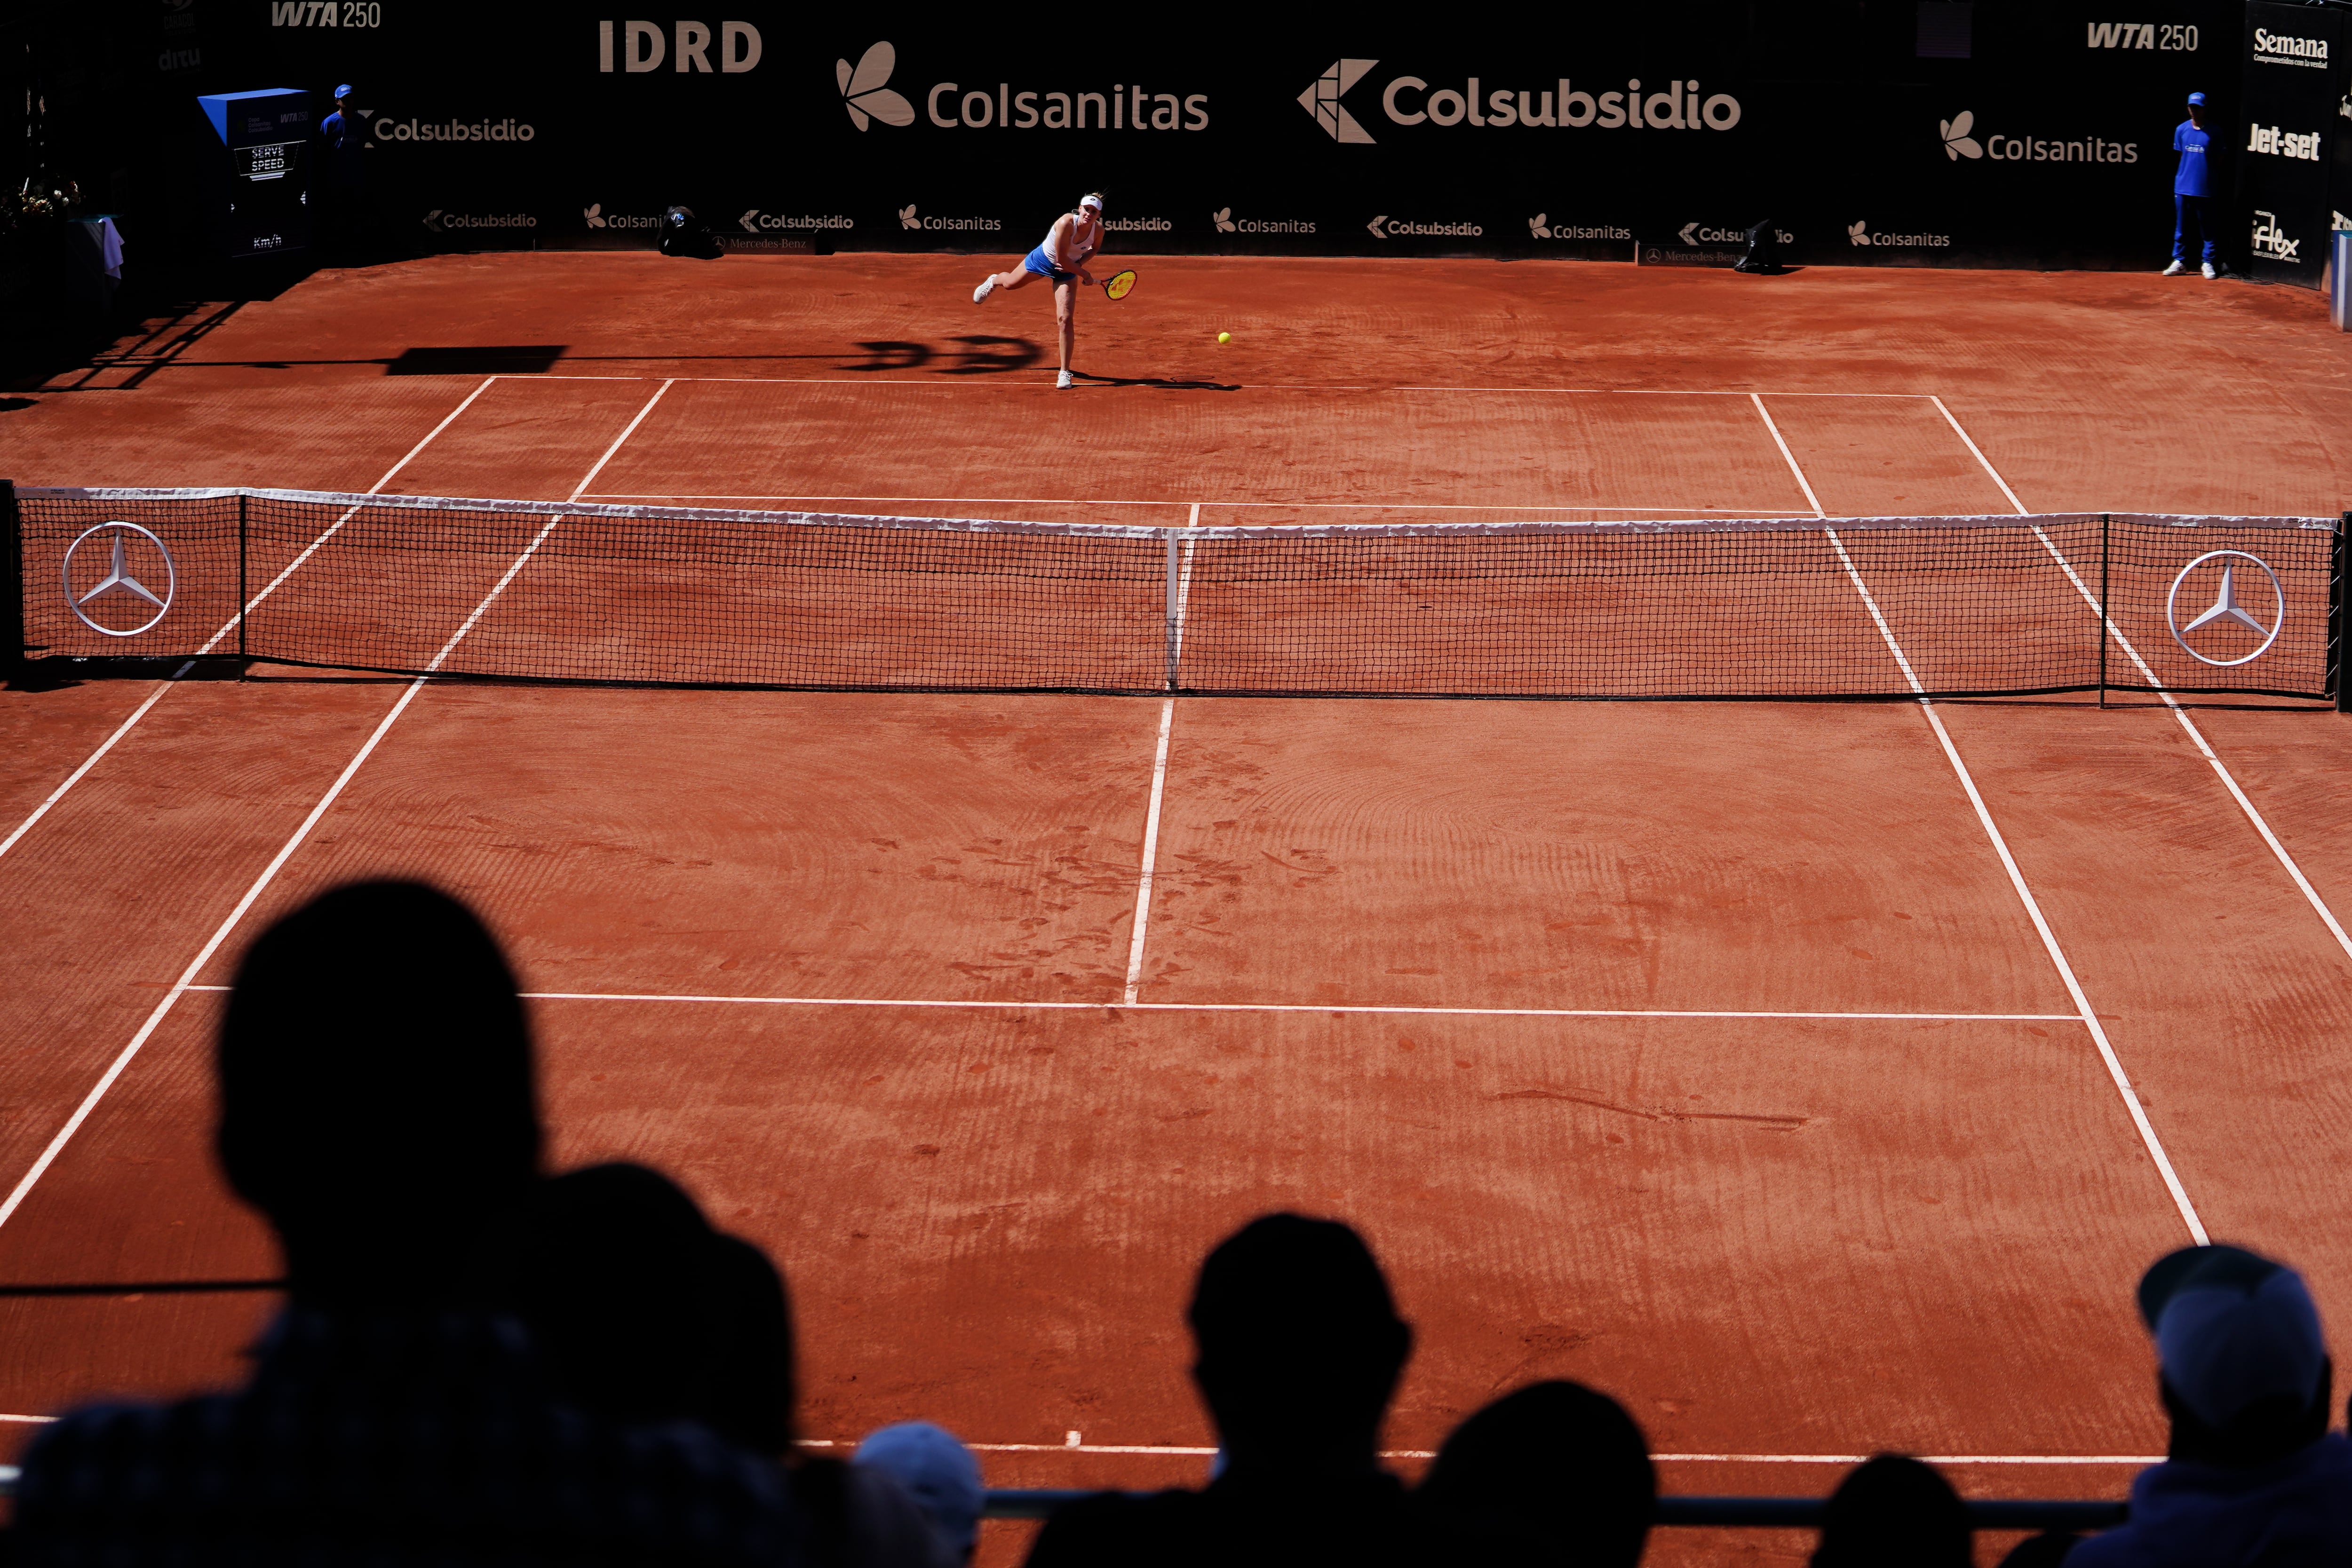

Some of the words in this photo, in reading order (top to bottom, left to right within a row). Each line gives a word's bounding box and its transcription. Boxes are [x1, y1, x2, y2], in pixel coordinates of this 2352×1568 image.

[272, 1, 337, 27] WTA
[343, 2, 381, 28] 250
[2088, 22, 2154, 49] WTA
[2160, 24, 2199, 51] 250
[2254, 28, 2328, 59] Semana
[599, 20, 763, 73] IDRD
[927, 82, 1209, 131] Colsanitas
[1382, 76, 1741, 131] Colsubsidio
[280, 112, 297, 123] WTA
[298, 111, 308, 121] 250
[374, 118, 535, 141] Colsubsidio
[1988, 135, 2138, 163] Colsanitas
[2247, 123, 2321, 161] Jet-set
[252, 145, 285, 159] SERVE
[252, 158, 285, 171] SPEED
[444, 214, 537, 228] Colsubsidio
[608, 214, 667, 228] Colsani
[759, 214, 854, 229] Colsubsidio
[923, 216, 1001, 230] Colsanitas
[1238, 219, 1316, 233] Colsanitas
[1388, 220, 1483, 236] Colsubsidio
[1554, 225, 1631, 239] Colsanitas
[1699, 228, 1794, 244] Colsuio
[1873, 232, 1950, 246] Colsanitas
[254, 234, 282, 248] Km/h
[730, 238, 806, 248] Mercedes-Benz
